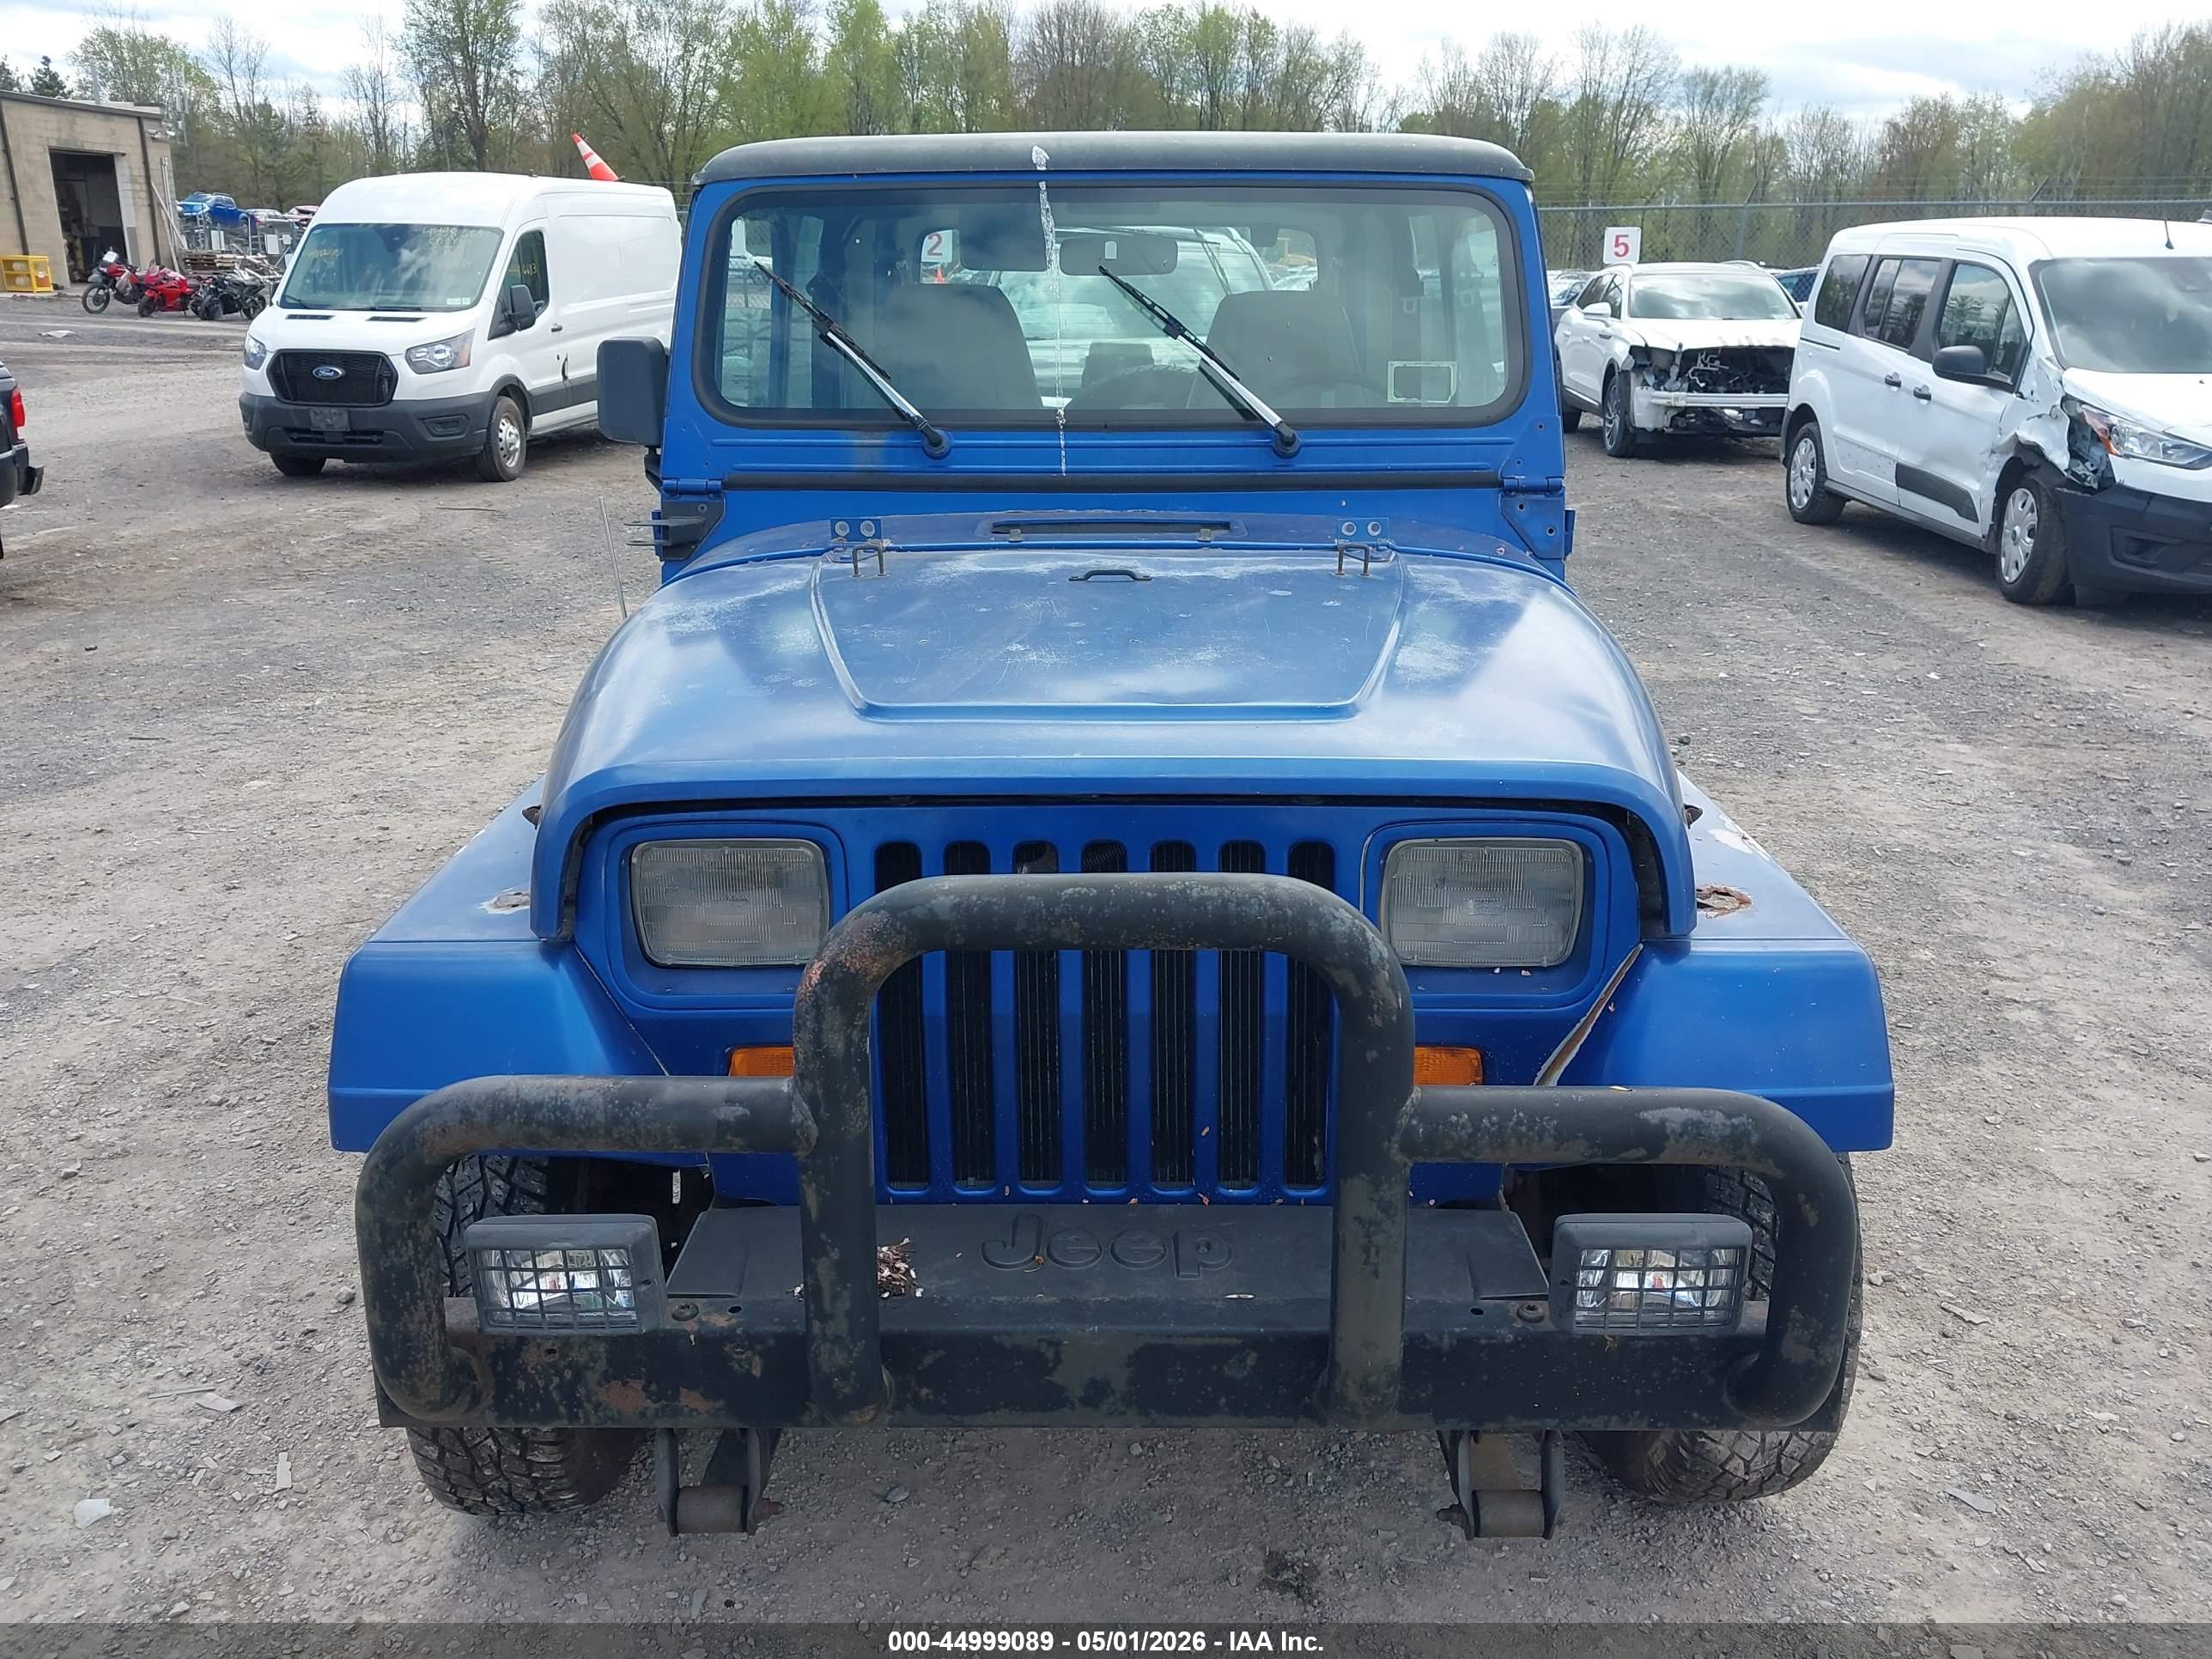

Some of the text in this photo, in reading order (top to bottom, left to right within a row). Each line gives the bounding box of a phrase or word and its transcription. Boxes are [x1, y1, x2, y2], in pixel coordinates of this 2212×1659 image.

[927, 233, 943, 257] 2
[1613, 234, 1630, 258] 5
[981, 1213, 1233, 1280] Jeep
